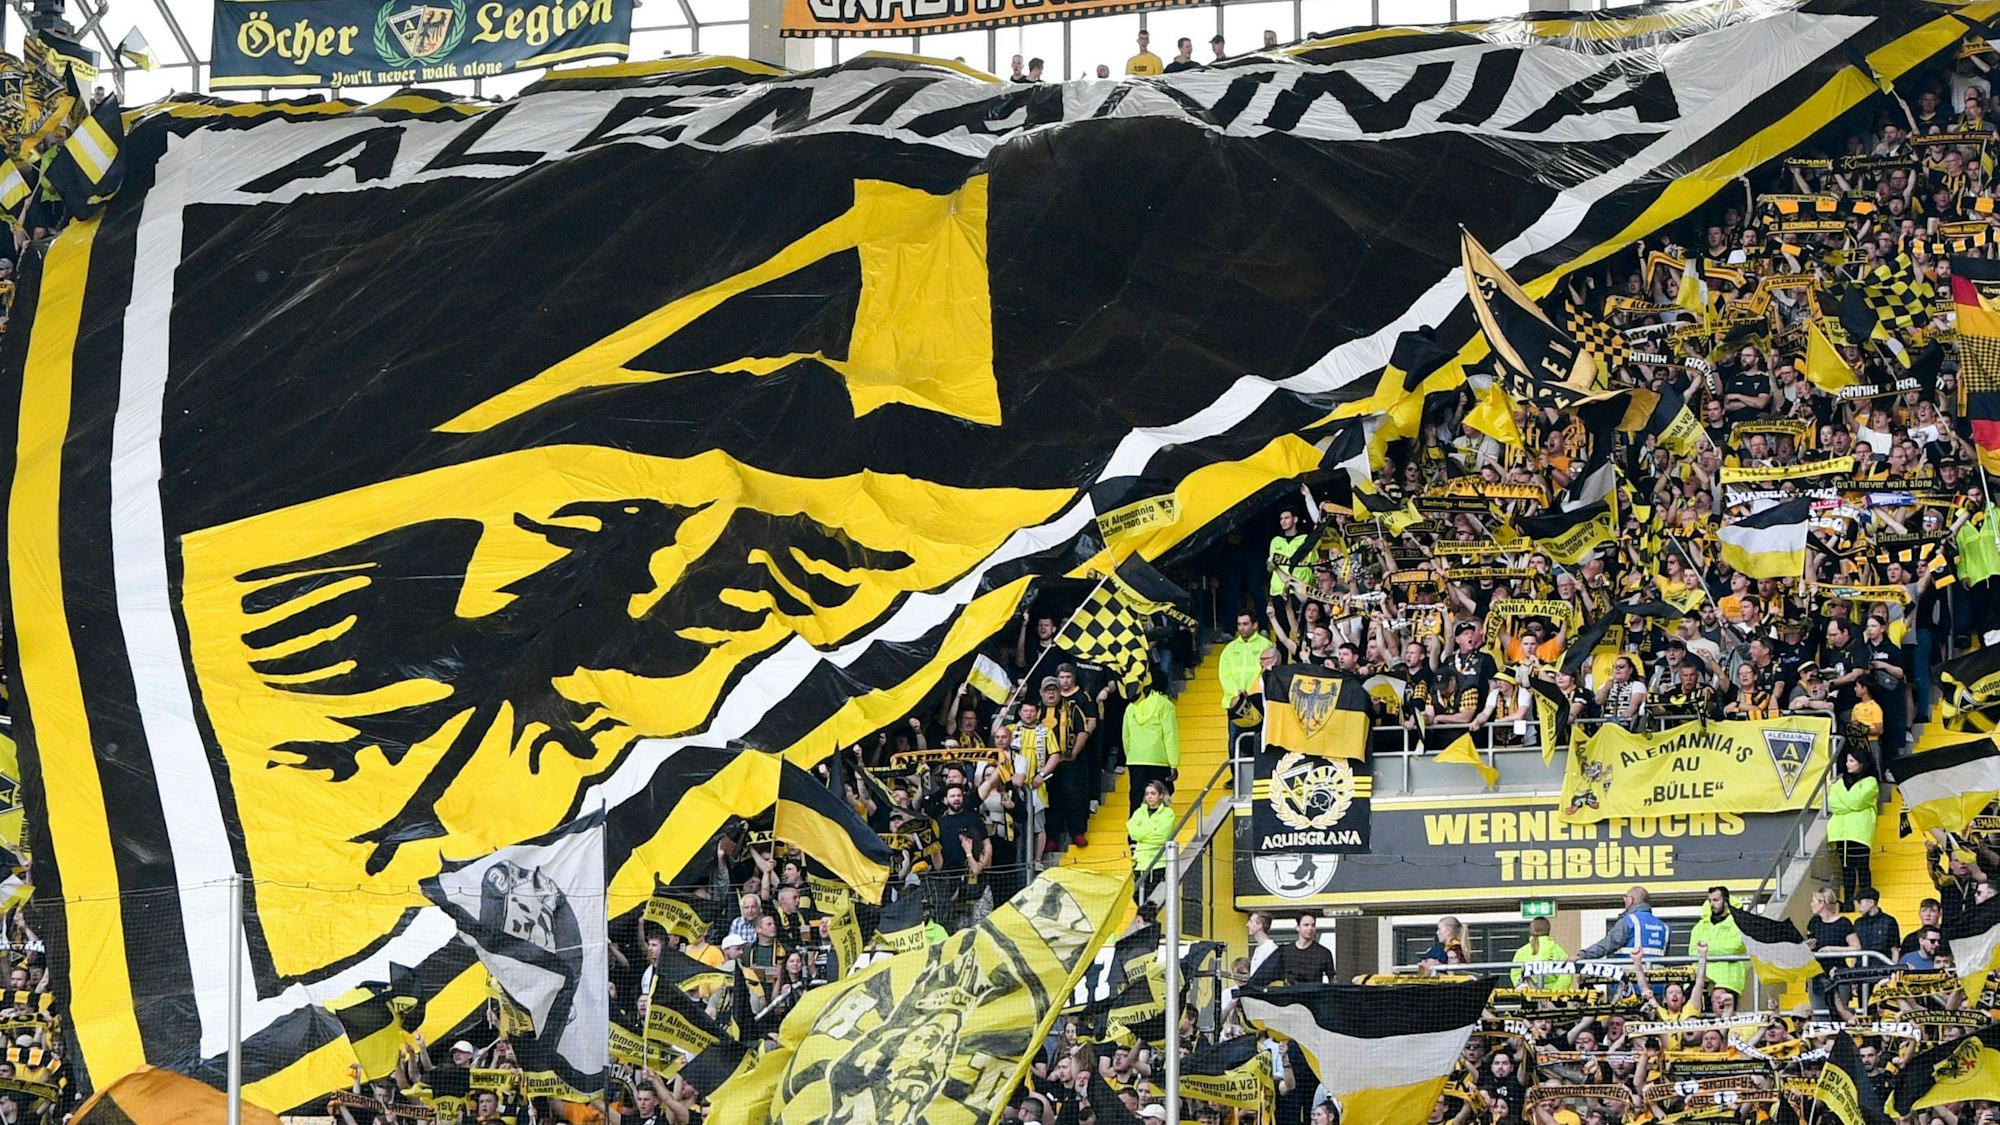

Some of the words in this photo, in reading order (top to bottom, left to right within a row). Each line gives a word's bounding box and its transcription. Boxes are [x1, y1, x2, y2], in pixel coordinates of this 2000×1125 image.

[237, 11, 358, 66] Öcher
[471, 0, 613, 47] Legion
[377, 67, 416, 84] never
[421, 62, 457, 80] walk
[463, 60, 503, 77] alone
[1858, 480, 1885, 489] never
[1887, 479, 1908, 489] walk
[1909, 479, 1933, 489] alone
[1620, 733, 1753, 767] ALEMANNIA'S
[1671, 756, 1700, 772] AU
[1261, 830, 1362, 850] AQUISGRANA
[1424, 810, 1598, 846] WERNER
[1608, 811, 1745, 839] FUCHS
[1494, 841, 1675, 881] TRIBÜNE
